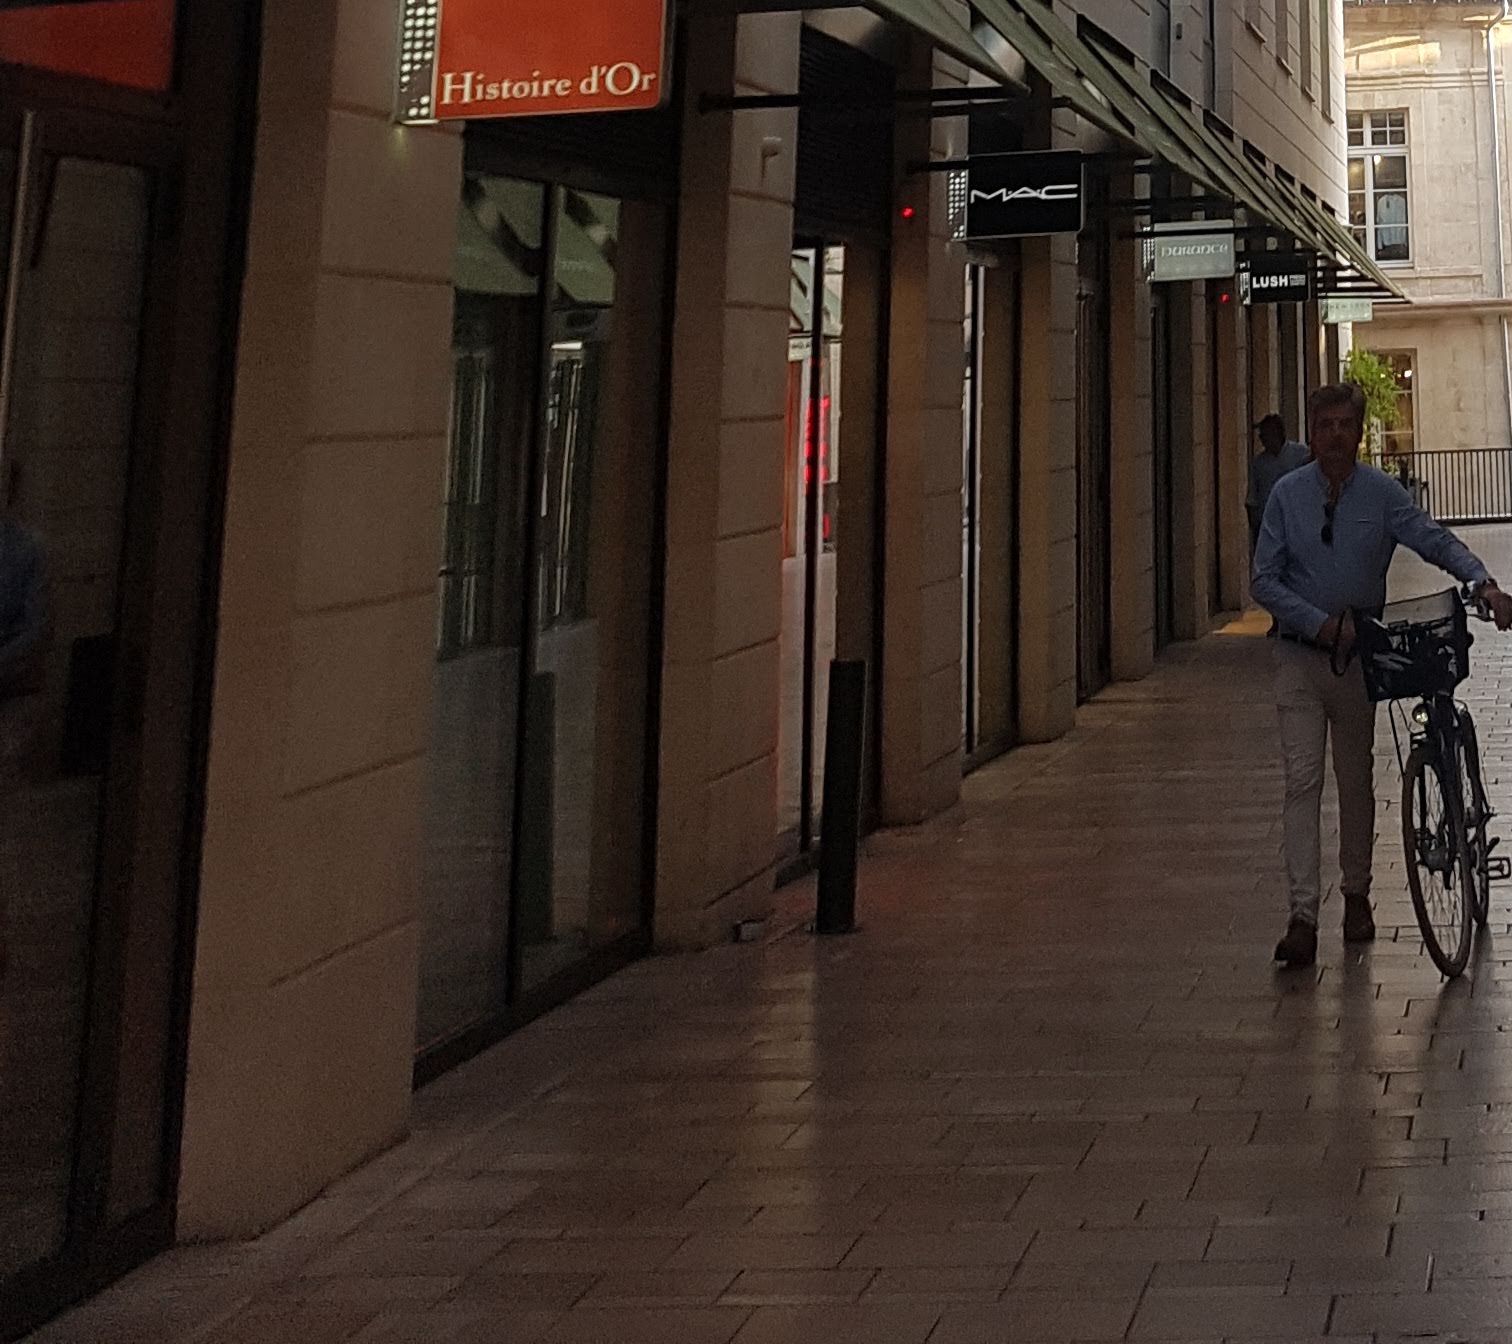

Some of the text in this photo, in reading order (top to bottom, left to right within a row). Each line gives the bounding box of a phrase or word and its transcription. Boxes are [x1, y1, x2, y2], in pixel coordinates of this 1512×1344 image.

[441, 61, 657, 105] Histoire d'Or
[1252, 274, 1289, 289] LUSH
